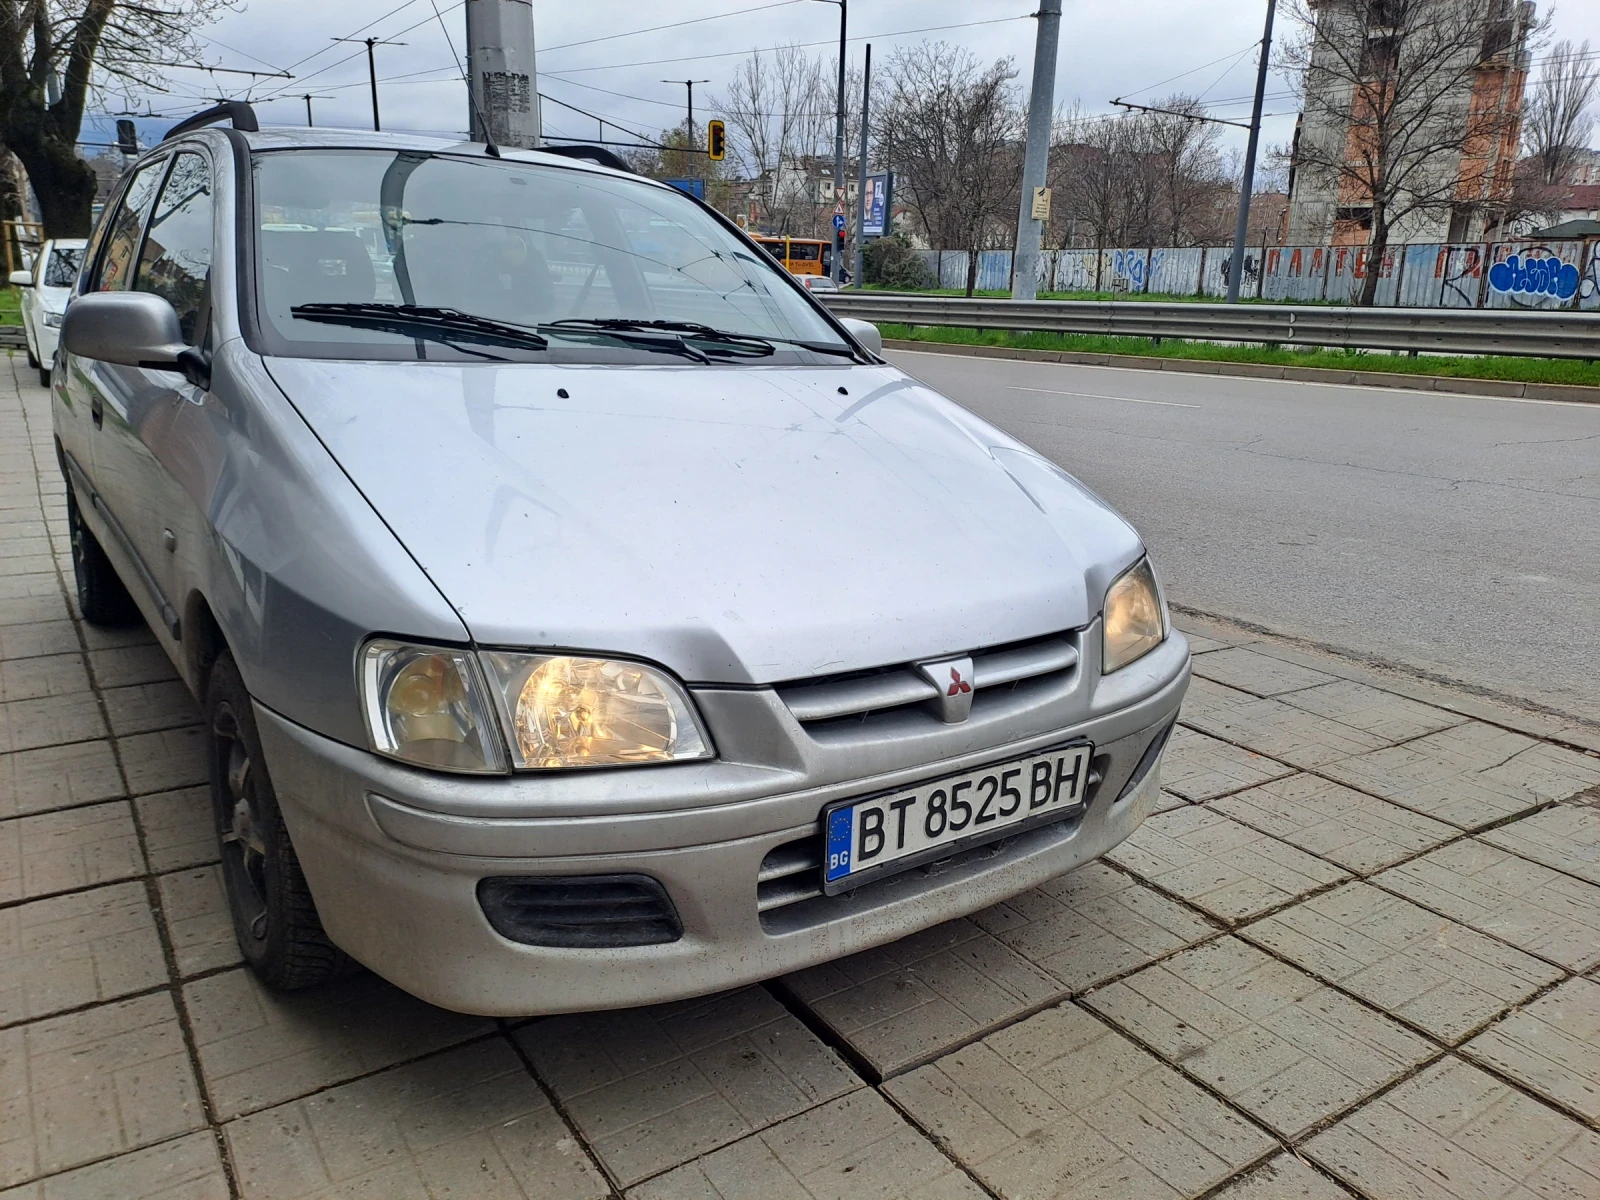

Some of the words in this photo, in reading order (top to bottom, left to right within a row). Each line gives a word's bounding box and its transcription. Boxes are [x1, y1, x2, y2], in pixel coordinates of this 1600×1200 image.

[858, 797, 916, 861] BT
[924, 769, 1021, 838] 8525
[1029, 754, 1083, 810] BH
[830, 851, 849, 870] BG
